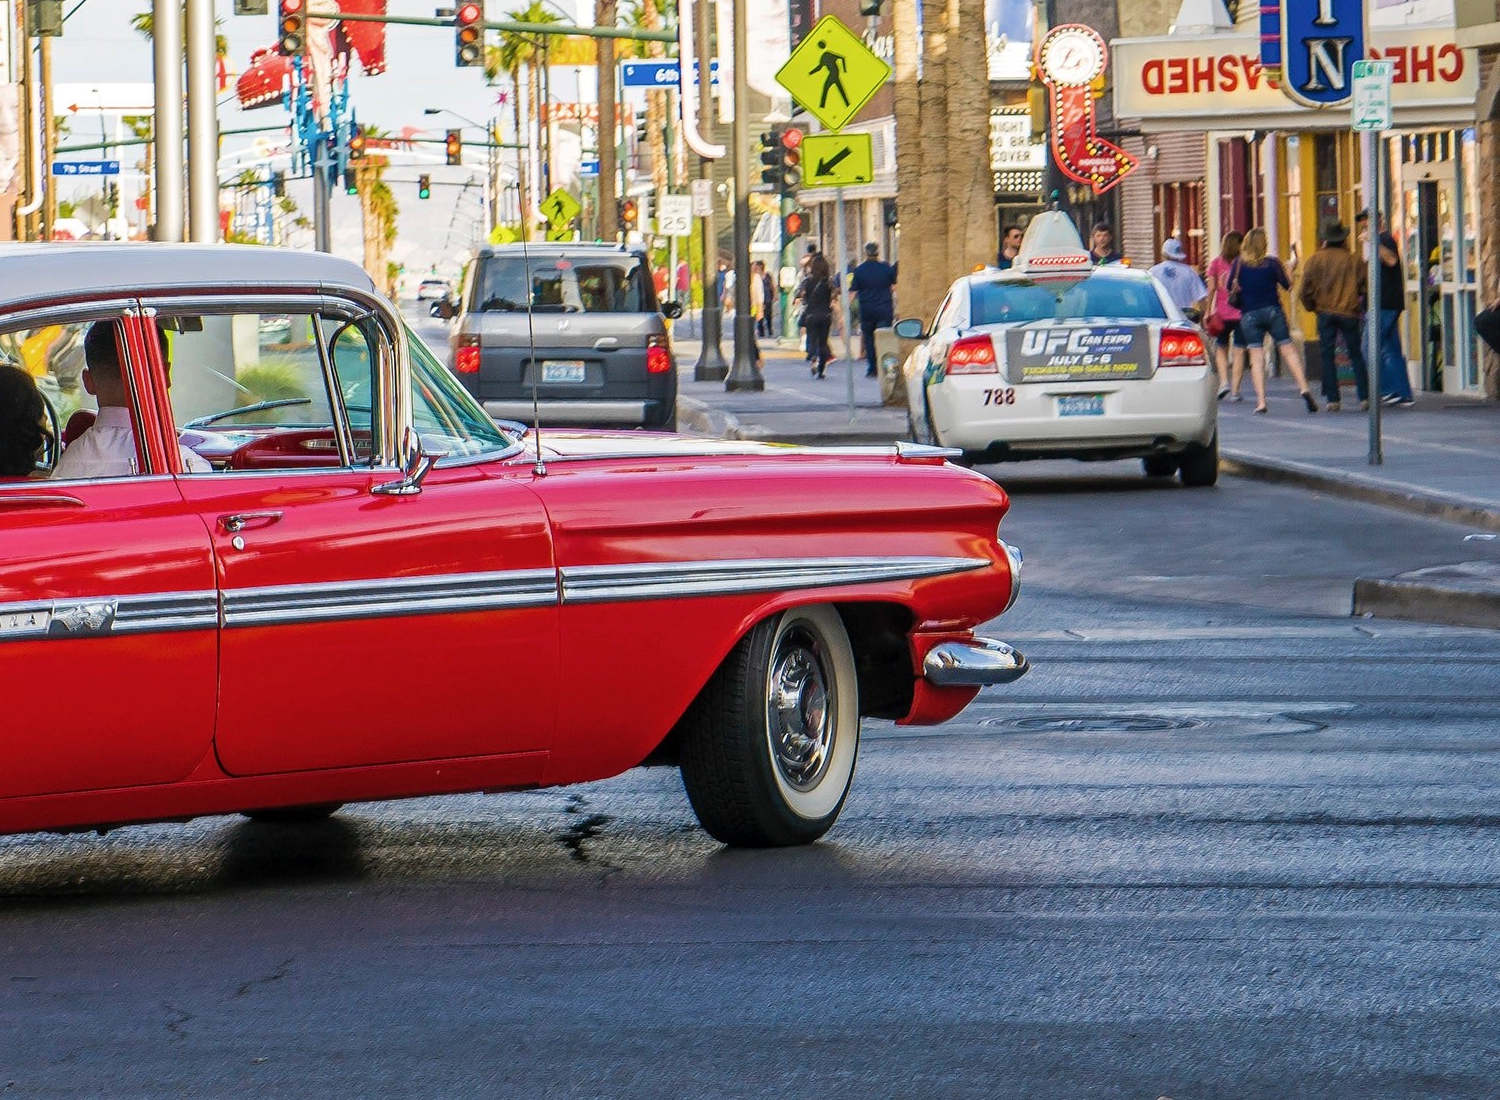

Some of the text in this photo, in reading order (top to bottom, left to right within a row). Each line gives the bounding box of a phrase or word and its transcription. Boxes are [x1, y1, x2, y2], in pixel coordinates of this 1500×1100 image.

[1141, 53, 1281, 95] ASHED
[662, 216, 687, 231] 25
[1020, 328, 1092, 357] UFC
[1080, 333, 1133, 346] FAN EXPO
[1047, 354, 1081, 366] JULY
[983, 388, 1016, 407] 788
